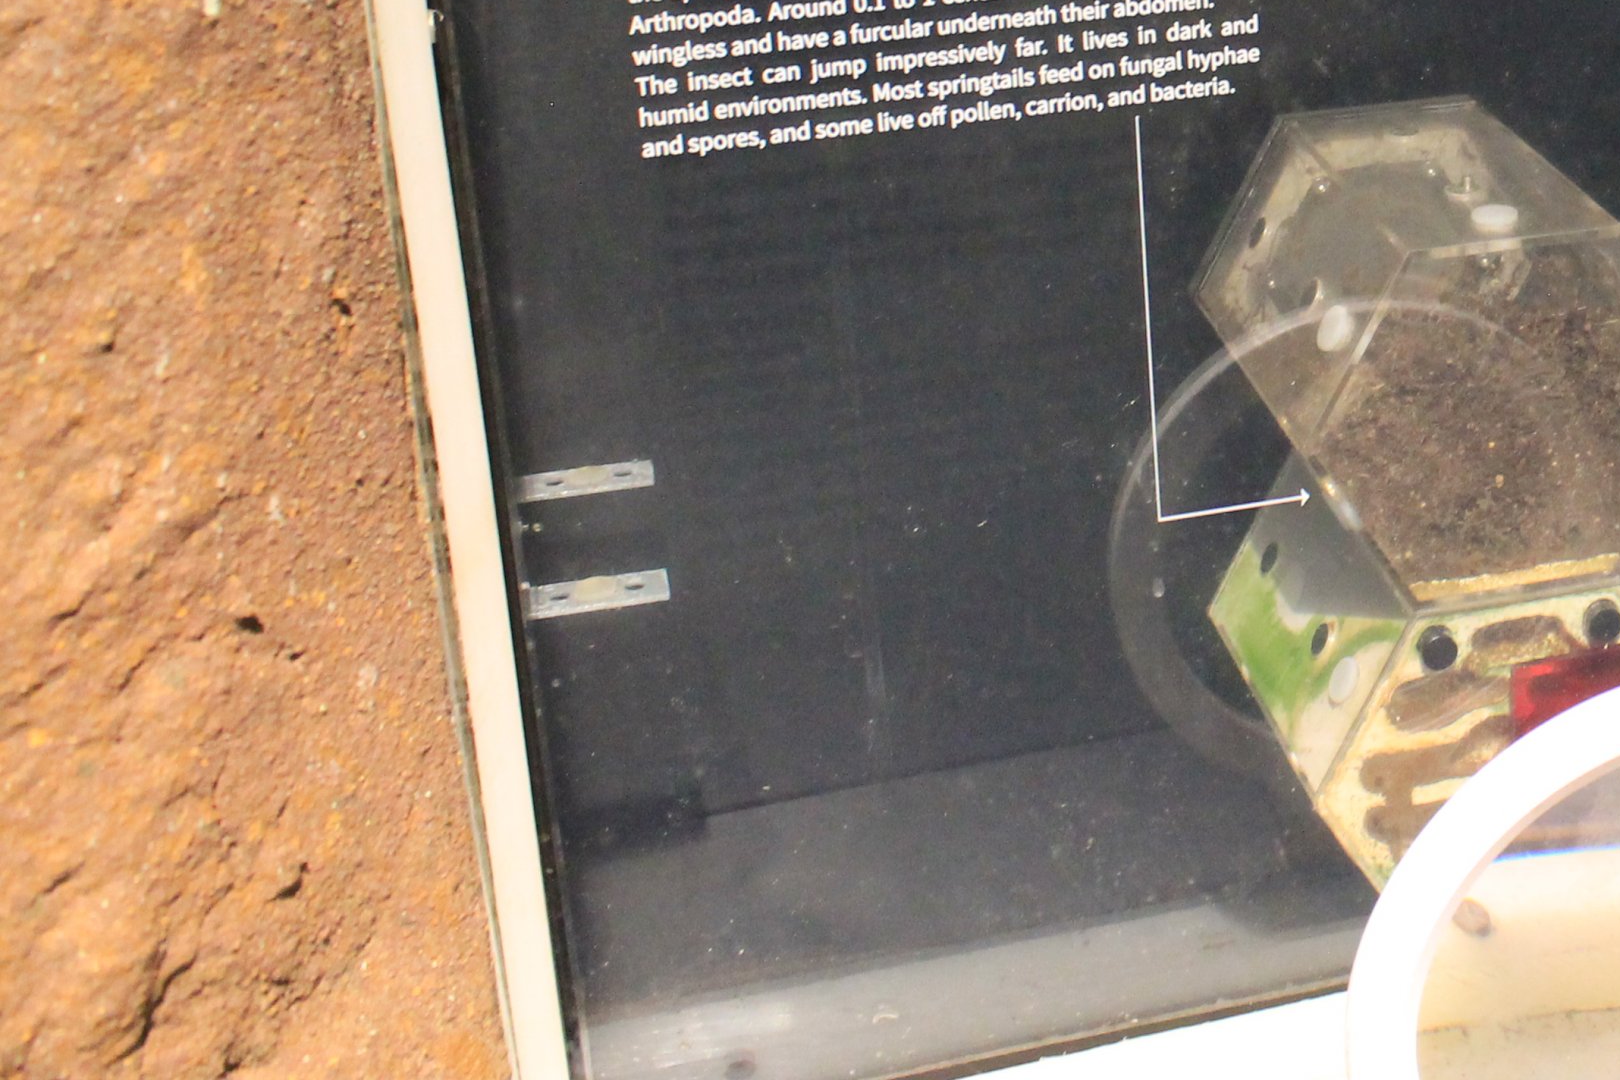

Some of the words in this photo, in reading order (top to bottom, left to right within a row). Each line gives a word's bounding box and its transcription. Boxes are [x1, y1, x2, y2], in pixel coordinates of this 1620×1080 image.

[629, 4, 761, 35] Arthropoda.
[632, 40, 727, 67] wingless
[731, 32, 772, 56] and
[777, 31, 829, 51] have
[833, 30, 846, 46] a
[850, 18, 934, 44] furcular
[937, 5, 1057, 35] underneath
[1060, 0, 1110, 23] their
[634, 75, 678, 96] The
[687, 67, 753, 91] insect
[762, 65, 801, 83] can
[810, 59, 866, 84] jump
[876, 40, 1006, 74] impressively
[1015, 37, 1048, 57] far.
[1058, 34, 1074, 53] It
[1083, 31, 1128, 50] lives
[1137, 26, 1156, 44] in
[1166, 19, 1212, 42] dark
[1221, 14, 1258, 36] and
[639, 100, 709, 127] humid
[714, 88, 867, 119] environments.
[873, 80, 924, 102] Most
[927, 67, 1035, 100] springtails
[1038, 61, 1083, 85] feed
[1088, 63, 1115, 79] on
[1119, 50, 1183, 78] fungal
[1187, 46, 1260, 72] hyphae
[642, 134, 683, 158] and
[688, 131, 766, 156] spores,
[770, 120, 811, 144] and
[815, 119, 873, 139] some
[877, 112, 914, 132] live
[918, 105, 947, 127] off
[951, 101, 1022, 128] pollen,
[1025, 92, 1104, 116] carrion,
[1108, 84, 1146, 107] and
[1150, 76, 1235, 102] bacteria.
